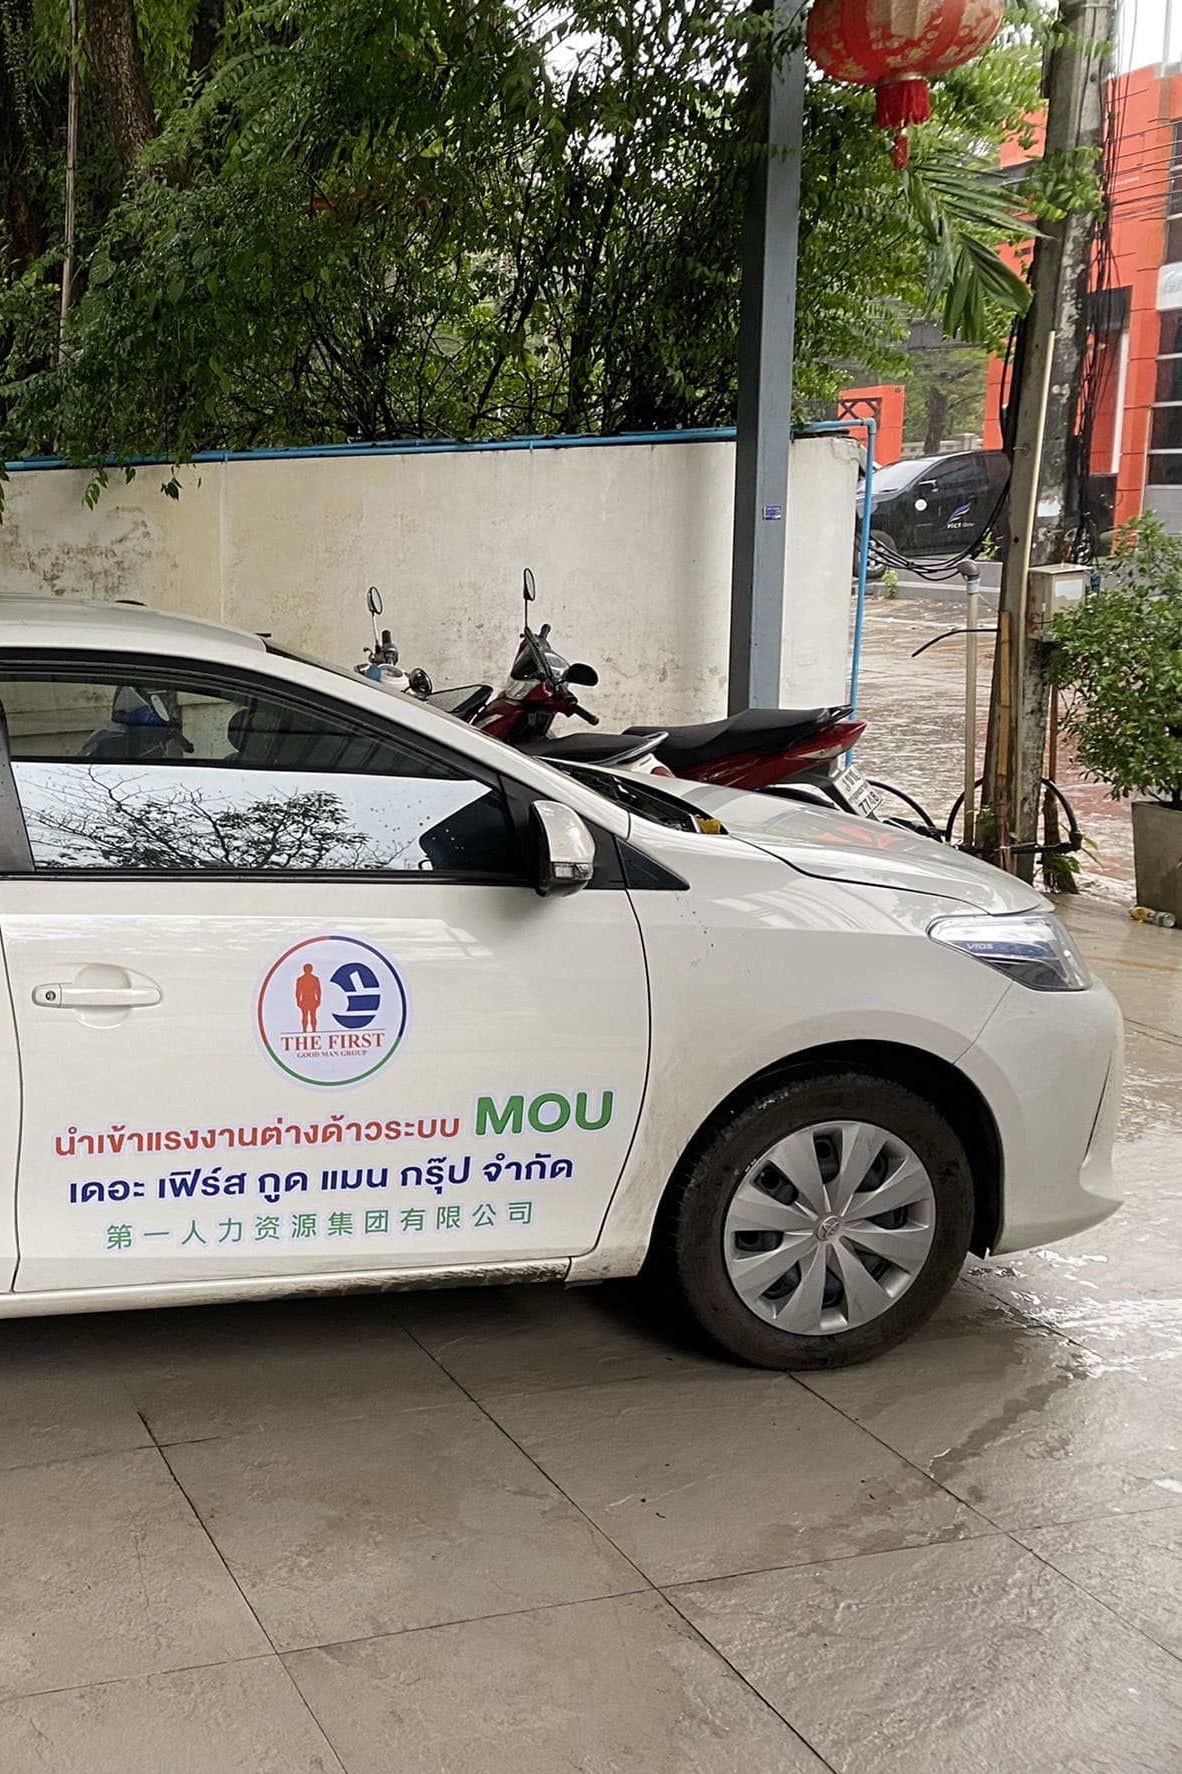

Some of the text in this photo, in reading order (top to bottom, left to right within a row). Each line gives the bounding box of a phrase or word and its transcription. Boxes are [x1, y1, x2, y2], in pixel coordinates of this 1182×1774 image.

[281, 1033, 386, 1052] THE FIRST
[297, 1049, 368, 1059] GOOD MAN GROUP
[55, 1091, 614, 1157] นำเข้าแรงงานต่างด้าวระบบ MOU
[69, 1152, 574, 1204] เดอะ เฟิร์ส กูด แมน กรุ๊ป จำกัด
[106, 1201, 534, 1250] 第一人力资源集团有限公司
